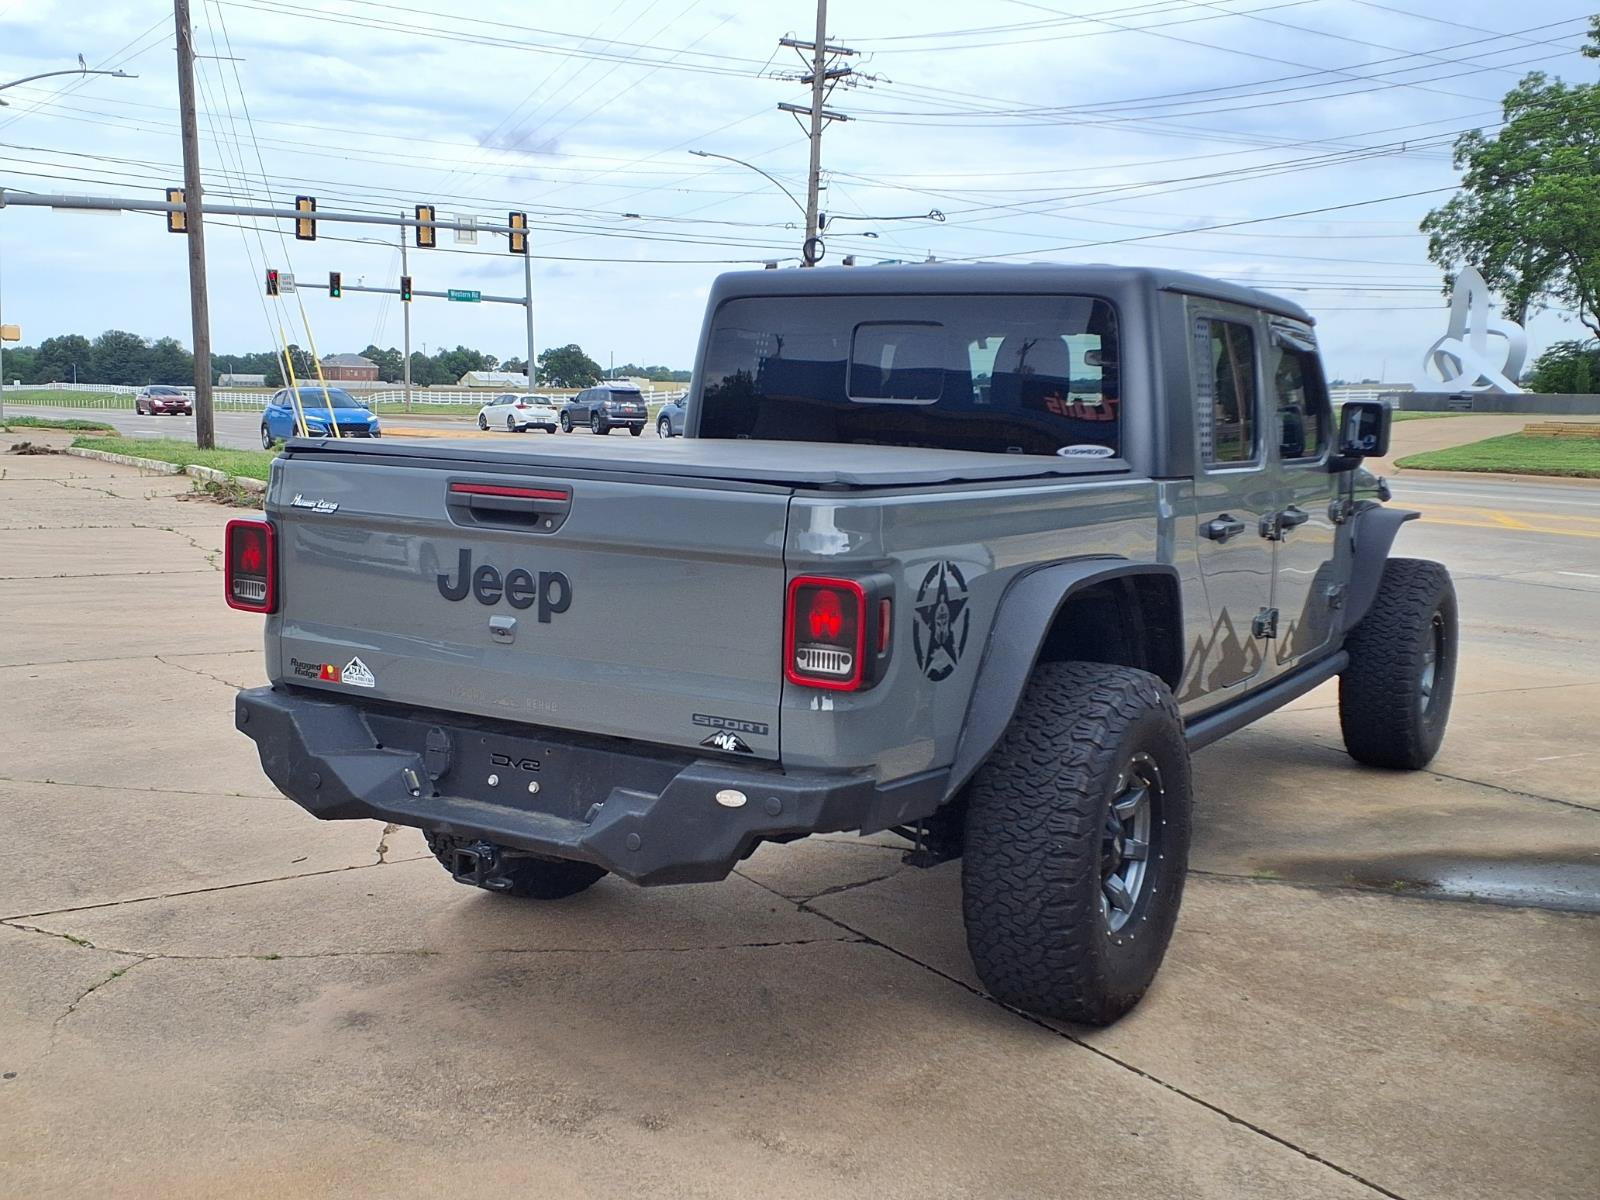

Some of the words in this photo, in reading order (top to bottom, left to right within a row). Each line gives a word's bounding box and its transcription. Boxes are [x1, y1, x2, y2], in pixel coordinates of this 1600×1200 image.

[450, 290, 471, 298] Western
[437, 548, 573, 624] Jeep
[290, 657, 322, 671] Rugged
[294, 666, 319, 679] Ridge
[692, 713, 769, 736] SPORT
